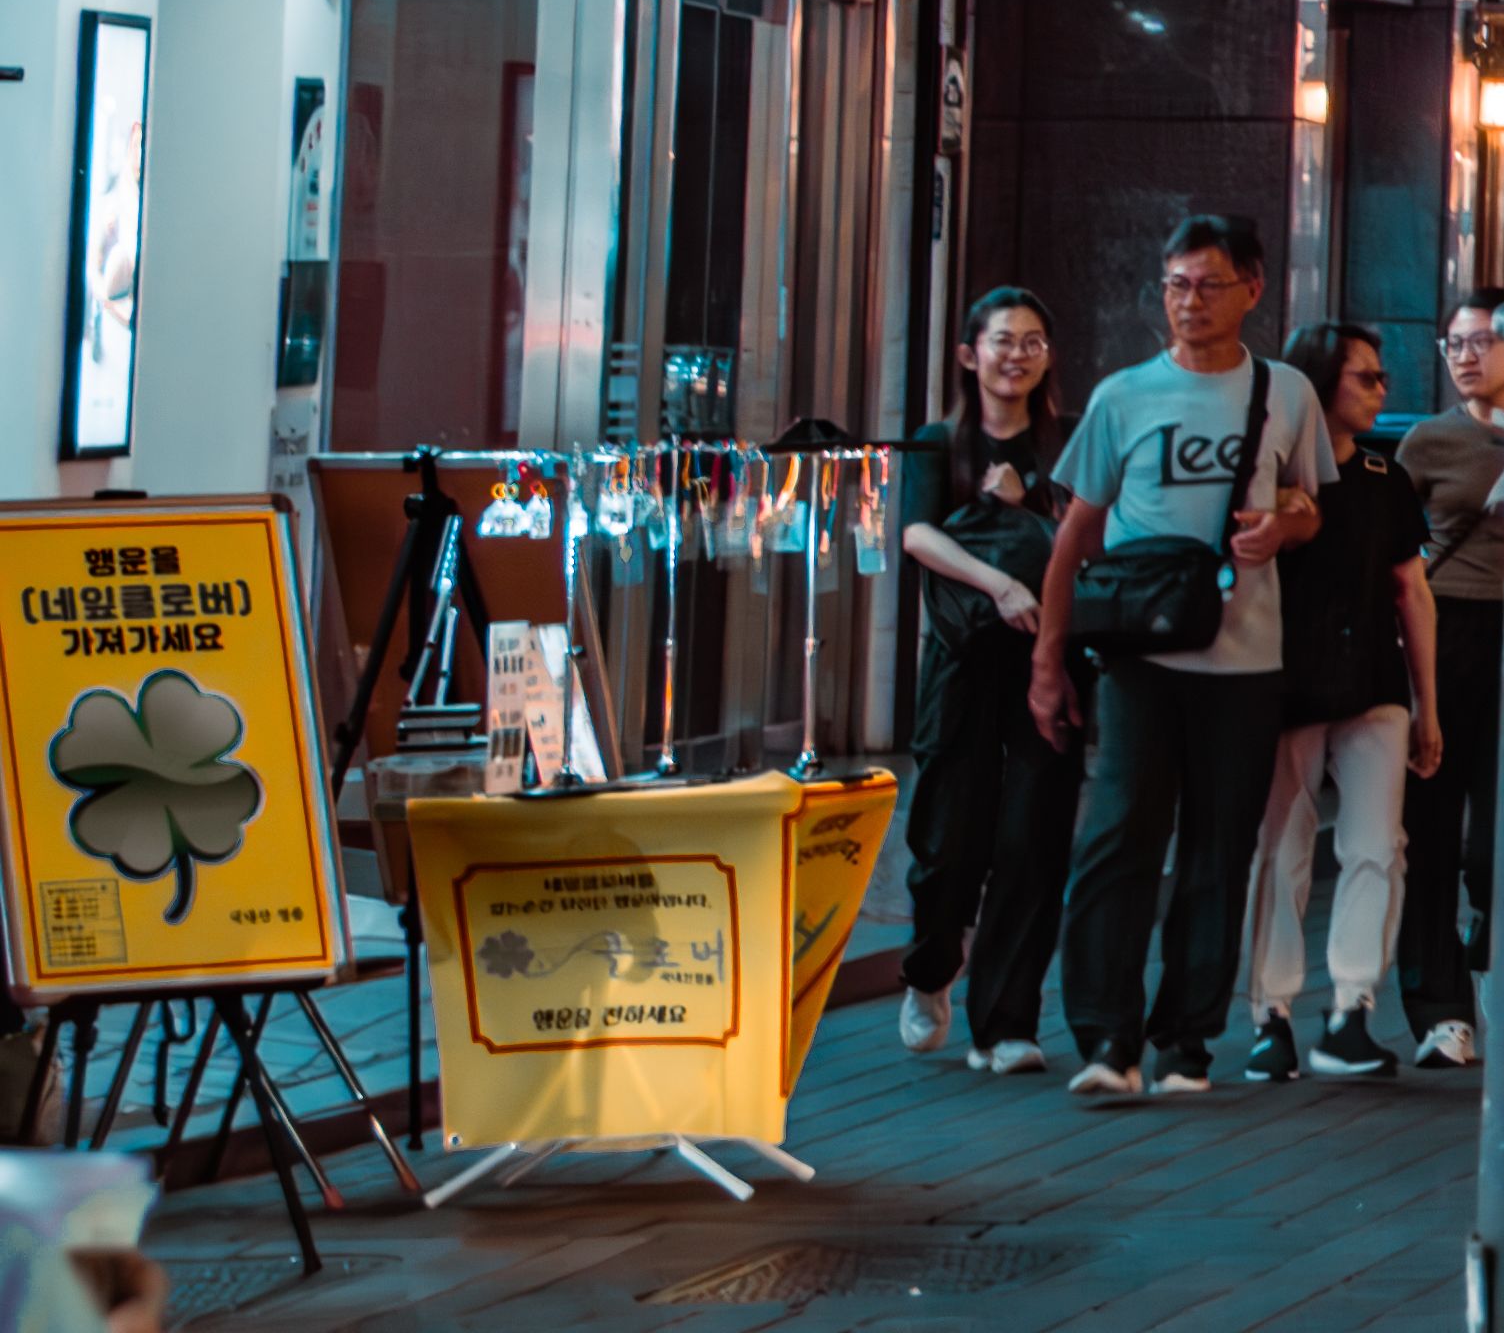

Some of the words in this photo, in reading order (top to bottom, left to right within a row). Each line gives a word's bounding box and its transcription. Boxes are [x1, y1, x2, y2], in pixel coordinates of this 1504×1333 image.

[1160, 423, 1242, 485] Lee
[83, 545, 182, 578] 행운을
[20, 579, 253, 625] (네잎클로버)
[61, 622, 225, 657] 가져가세요
